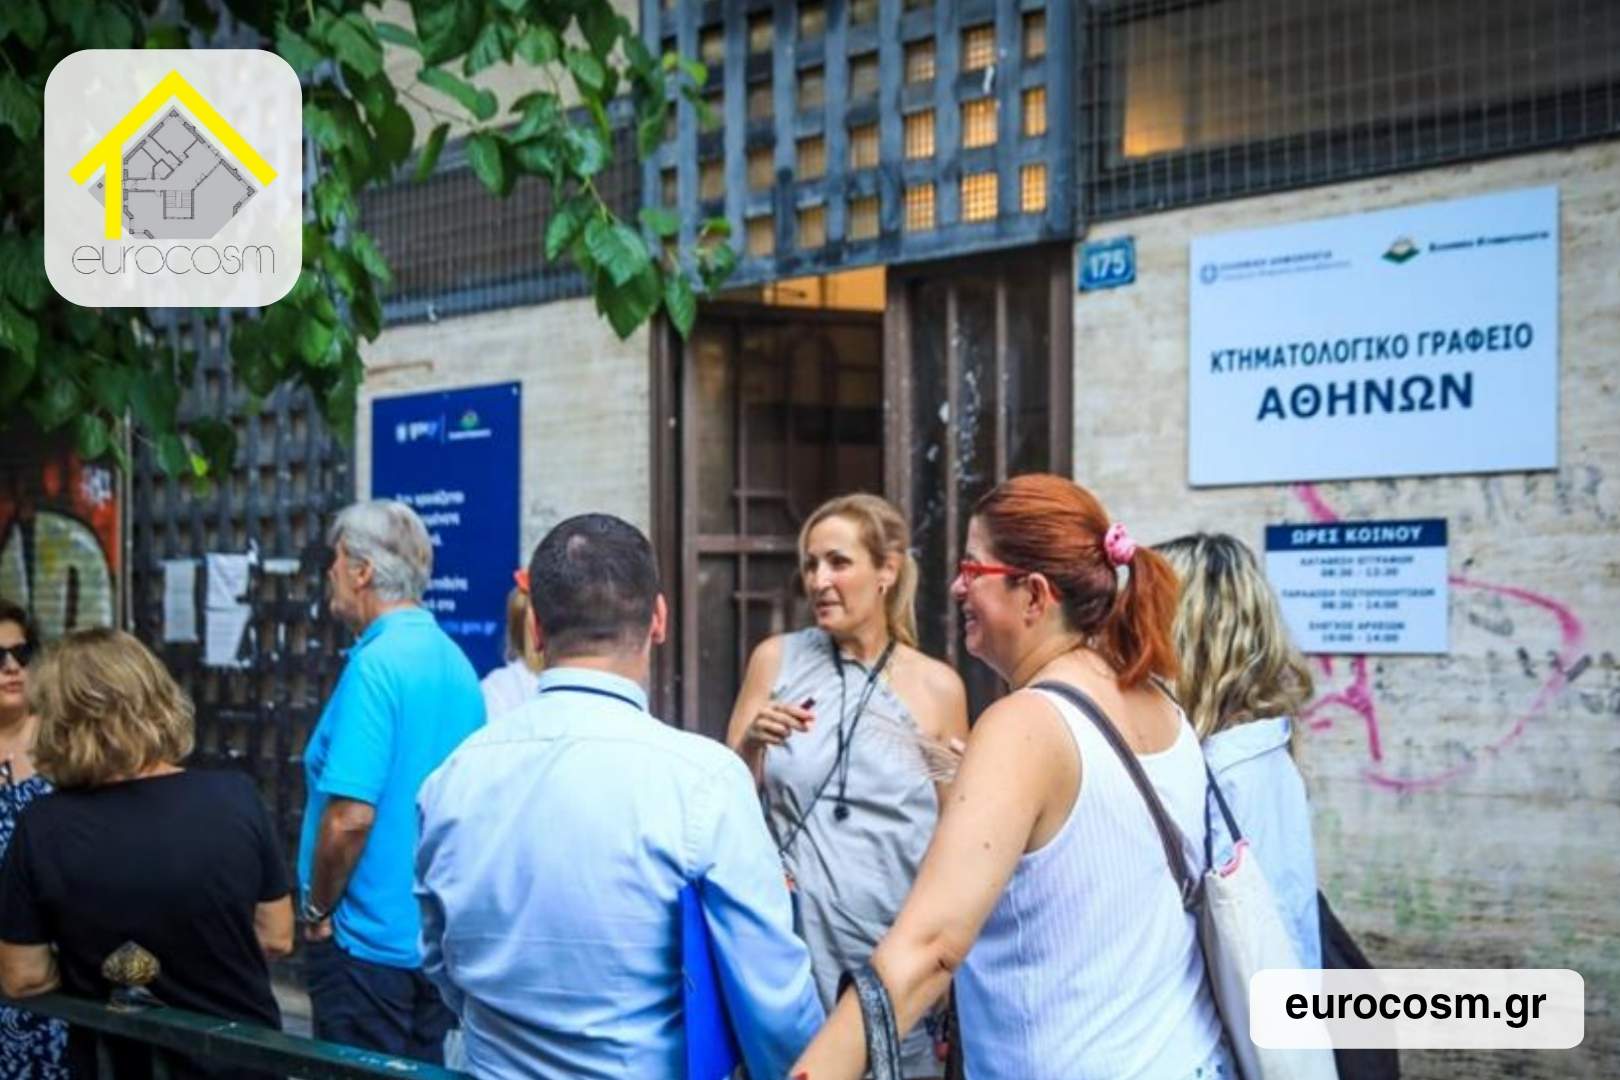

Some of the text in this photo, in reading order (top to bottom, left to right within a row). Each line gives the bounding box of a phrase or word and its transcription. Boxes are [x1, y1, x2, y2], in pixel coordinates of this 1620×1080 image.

[1090, 249, 1126, 279] 175
[1210, 322, 1534, 373] ΚΤΗΜΑΤΟΛΟΓΙΚΟ ΓΡΑΦΕΙΟ
[1256, 371, 1474, 422] ΑΘΗΝΩΝ
[1291, 526, 1424, 545] ΩΡΕΣ ΚΟΙΝΟΥ
